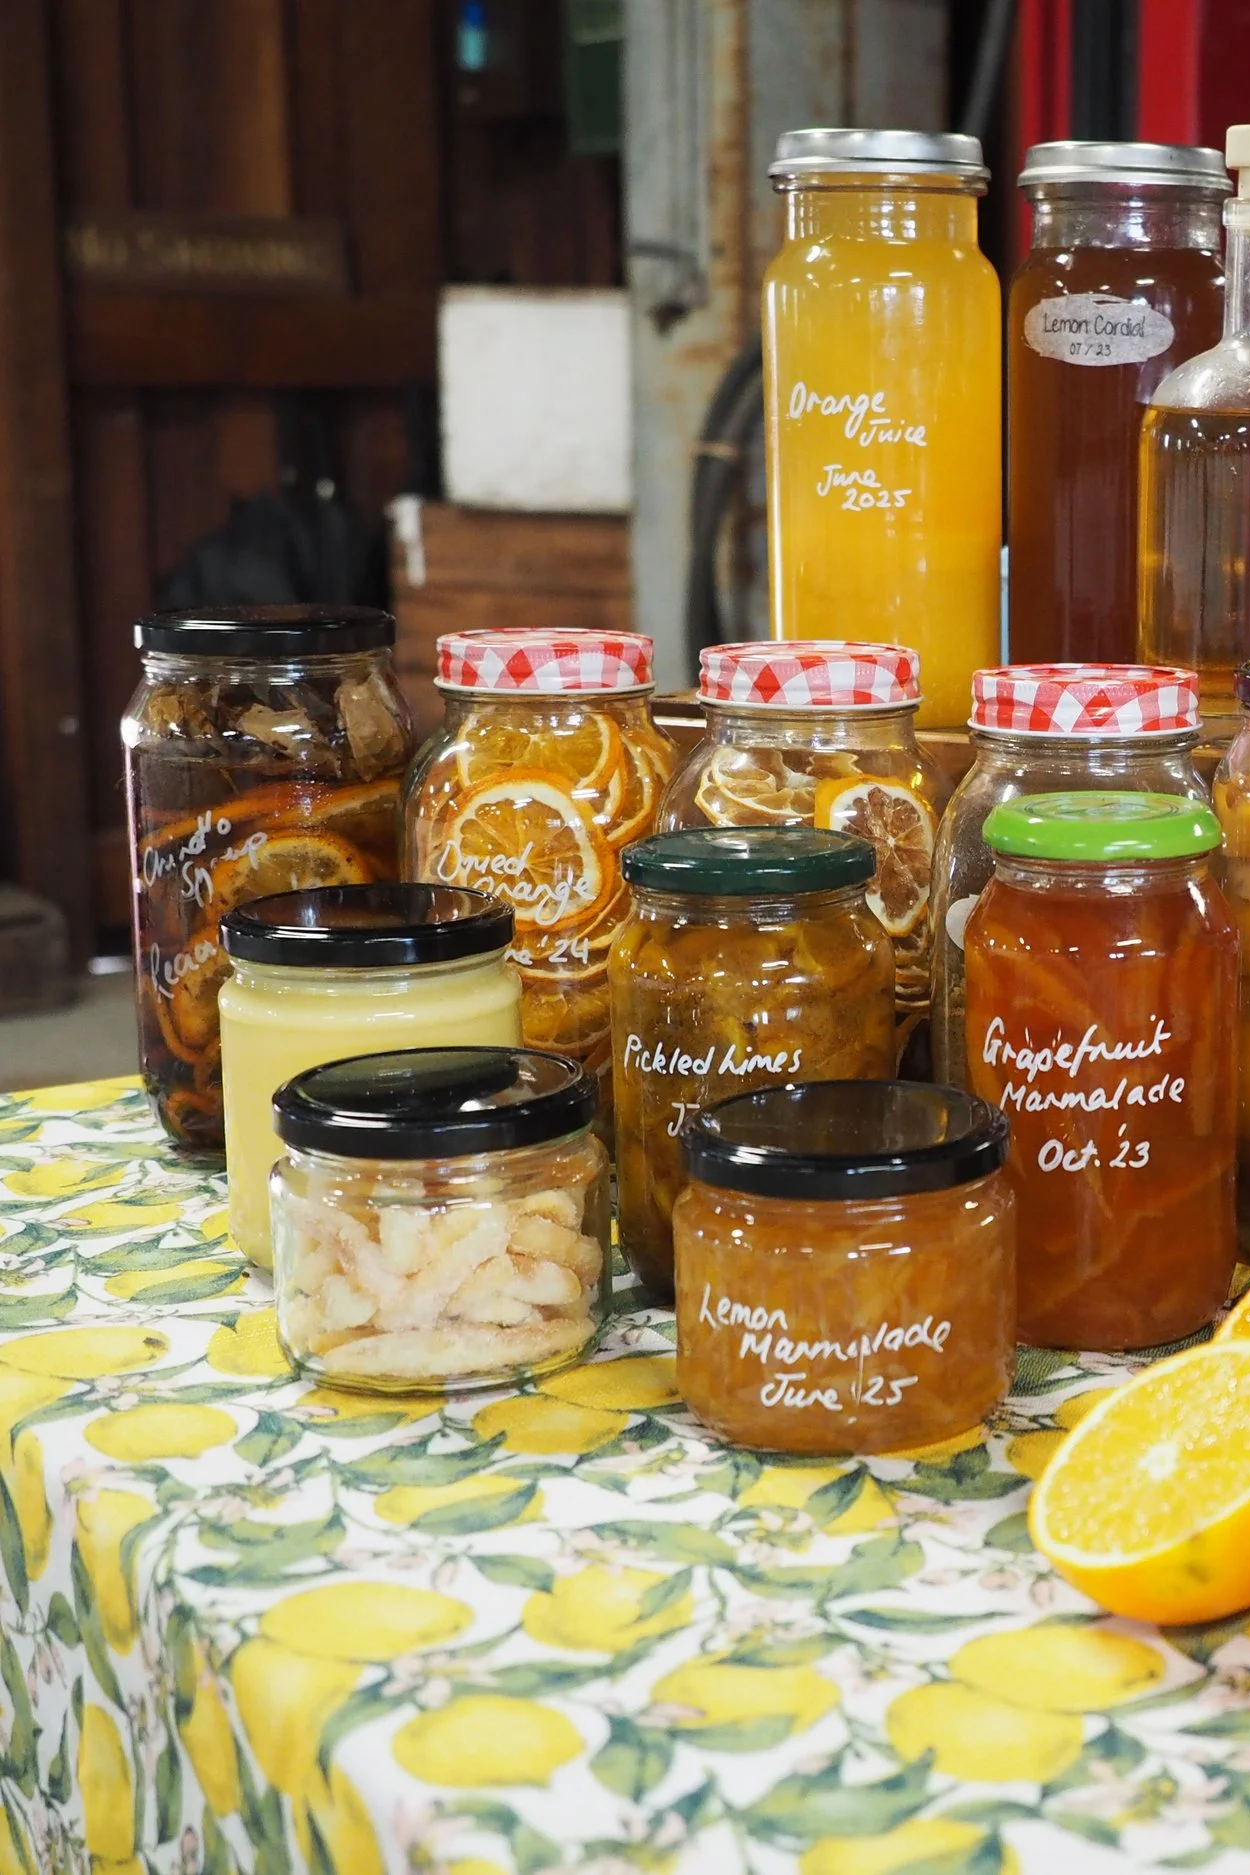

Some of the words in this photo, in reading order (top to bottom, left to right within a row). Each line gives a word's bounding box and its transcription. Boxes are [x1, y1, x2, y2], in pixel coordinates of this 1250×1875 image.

[1043, 313, 1088, 334] Lemon
[1094, 315, 1146, 338] Cordial
[789, 381, 886, 439] Orange
[859, 418, 927, 447] Juice
[816, 464, 881, 496] June
[841, 489, 912, 511] 2025
[624, 1033, 715, 1076] Pickled
[718, 1044, 802, 1075] Limes
[982, 1014, 1172, 1083] Grapefruit
[1000, 1073, 1185, 1112] Marmalade
[699, 1282, 788, 1330] Lemon
[739, 1315, 951, 1364] Marmalade
[760, 1373, 843, 1411] June
